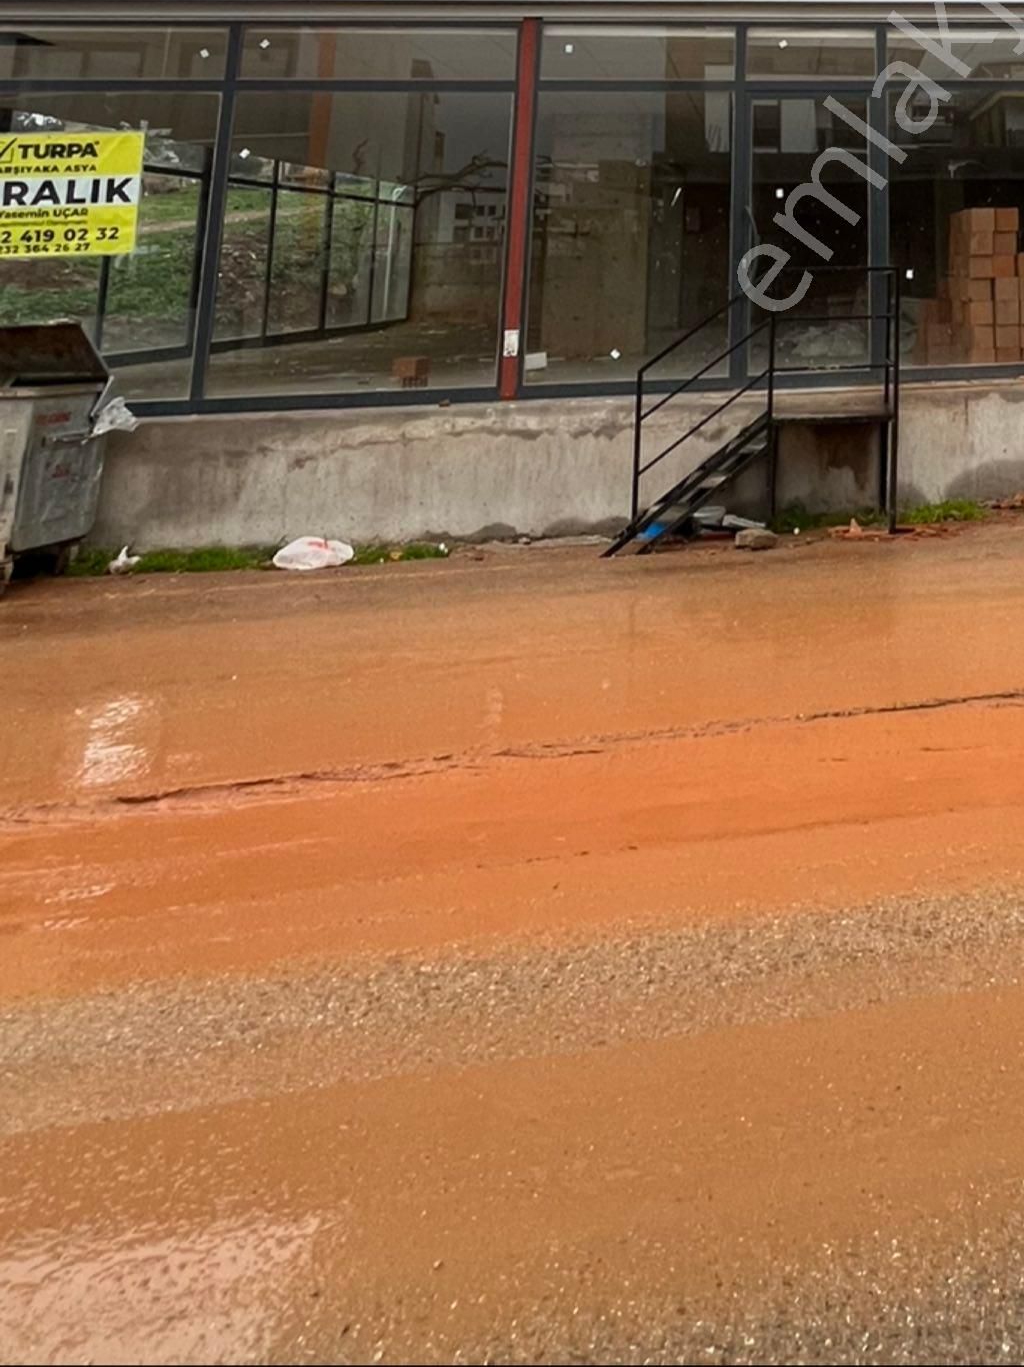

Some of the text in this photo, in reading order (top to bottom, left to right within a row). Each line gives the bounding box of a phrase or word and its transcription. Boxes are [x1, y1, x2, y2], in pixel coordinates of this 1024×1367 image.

[18, 142, 98, 159] TURPA
[64, 164, 97, 172] ASYA
[3, 178, 133, 206] RALIK
[1, 230, 12, 243] 2
[63, 228, 88, 241] 02
[96, 226, 119, 241] 32
[54, 243, 70, 252] 26
[75, 242, 91, 251] 27
